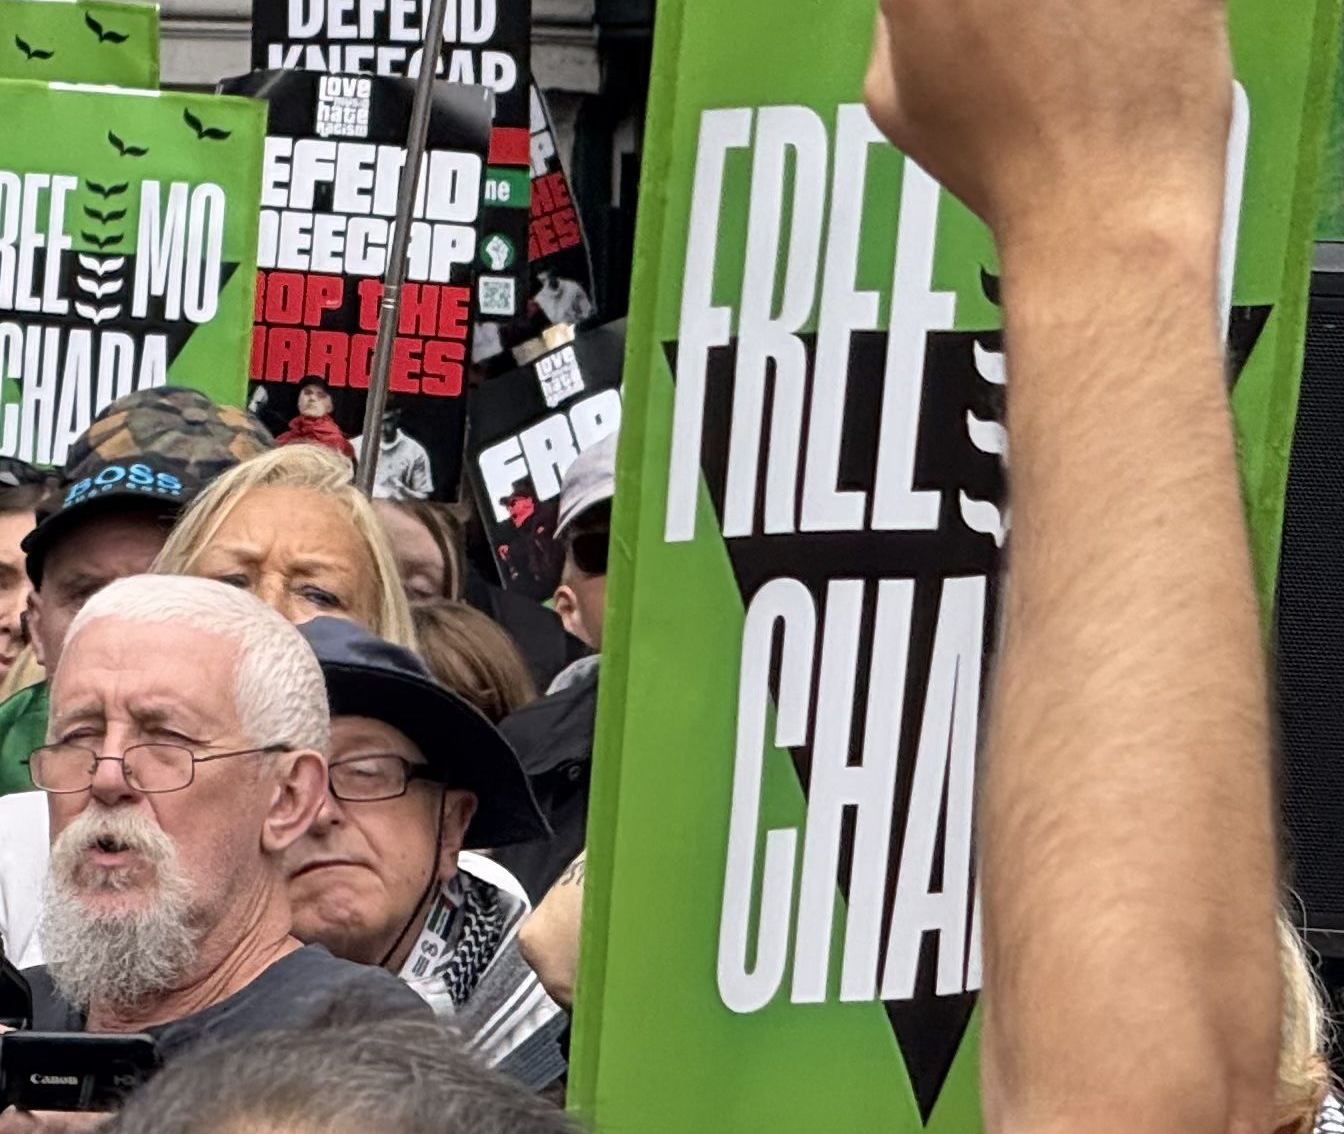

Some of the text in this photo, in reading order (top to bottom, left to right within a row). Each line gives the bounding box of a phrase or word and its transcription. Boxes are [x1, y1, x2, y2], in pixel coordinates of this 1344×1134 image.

[260, 135, 483, 224] EFEND
[130, 179, 226, 324] MO
[663, 103, 957, 543] FREE
[64, 463, 182, 503] BOSS
[716, 575, 985, 1014] CHA
[29, 1073, 79, 1086] Canon
